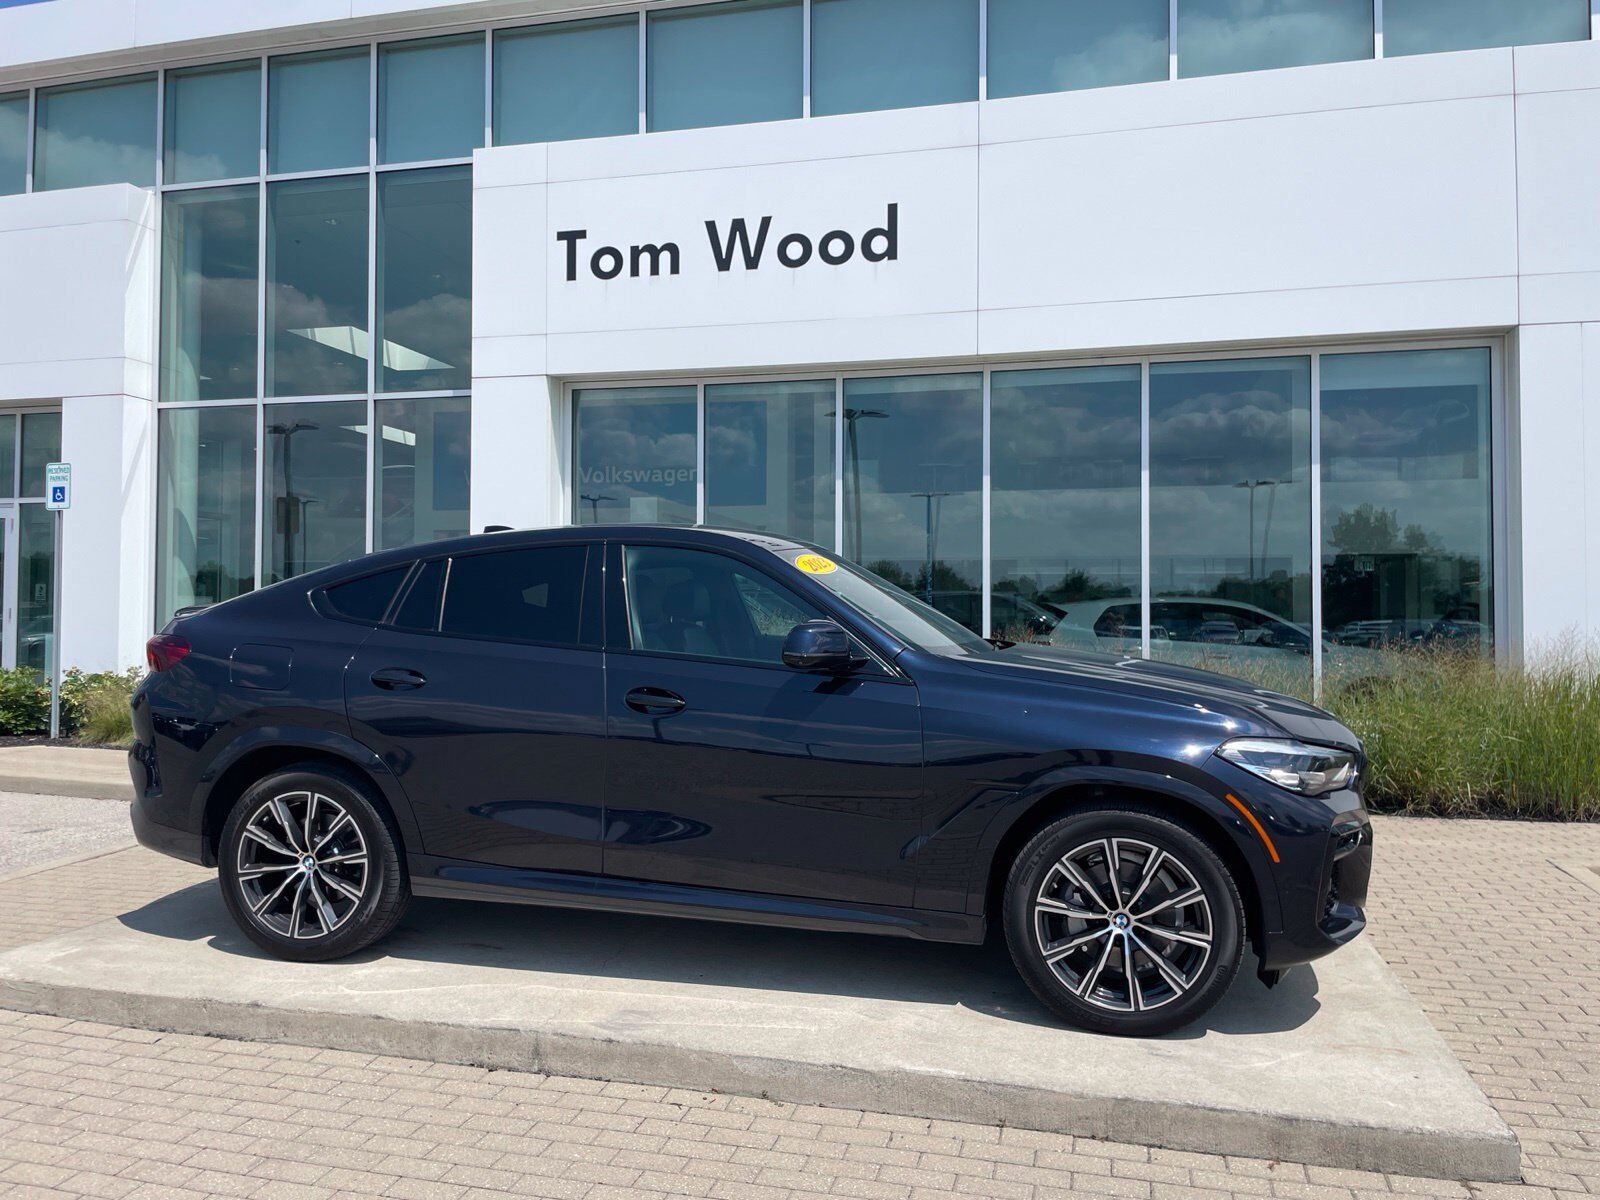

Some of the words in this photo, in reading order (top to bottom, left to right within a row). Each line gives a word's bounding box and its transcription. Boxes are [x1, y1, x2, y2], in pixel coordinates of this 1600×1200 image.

[556, 229, 680, 282] Tom
[704, 202, 898, 272] Wood
[48, 466, 70, 474] RESERVED
